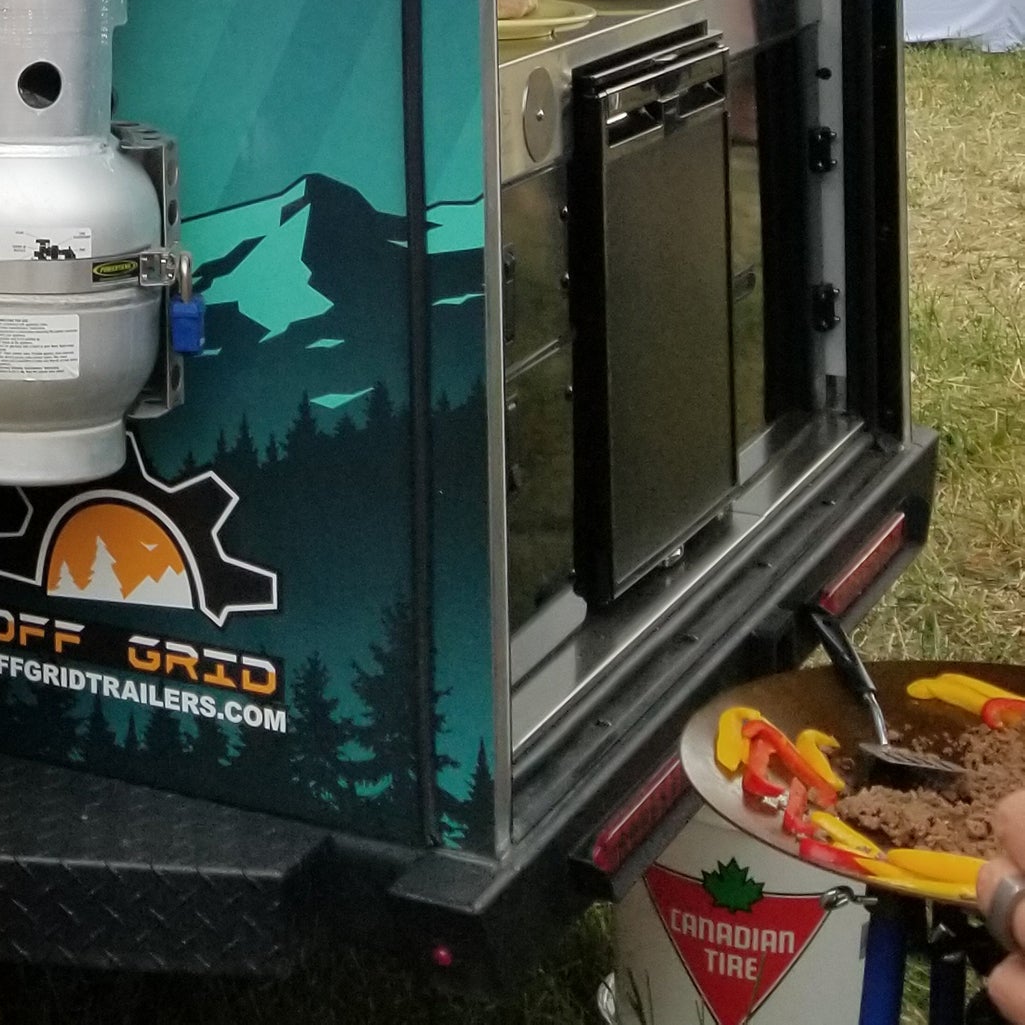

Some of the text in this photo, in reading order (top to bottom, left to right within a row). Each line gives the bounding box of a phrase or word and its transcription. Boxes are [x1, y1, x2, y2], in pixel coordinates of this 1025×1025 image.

[128, 635, 276, 695] GRID
[671, 908, 795, 954] CANADIAN
[704, 948, 757, 981] TIRE
